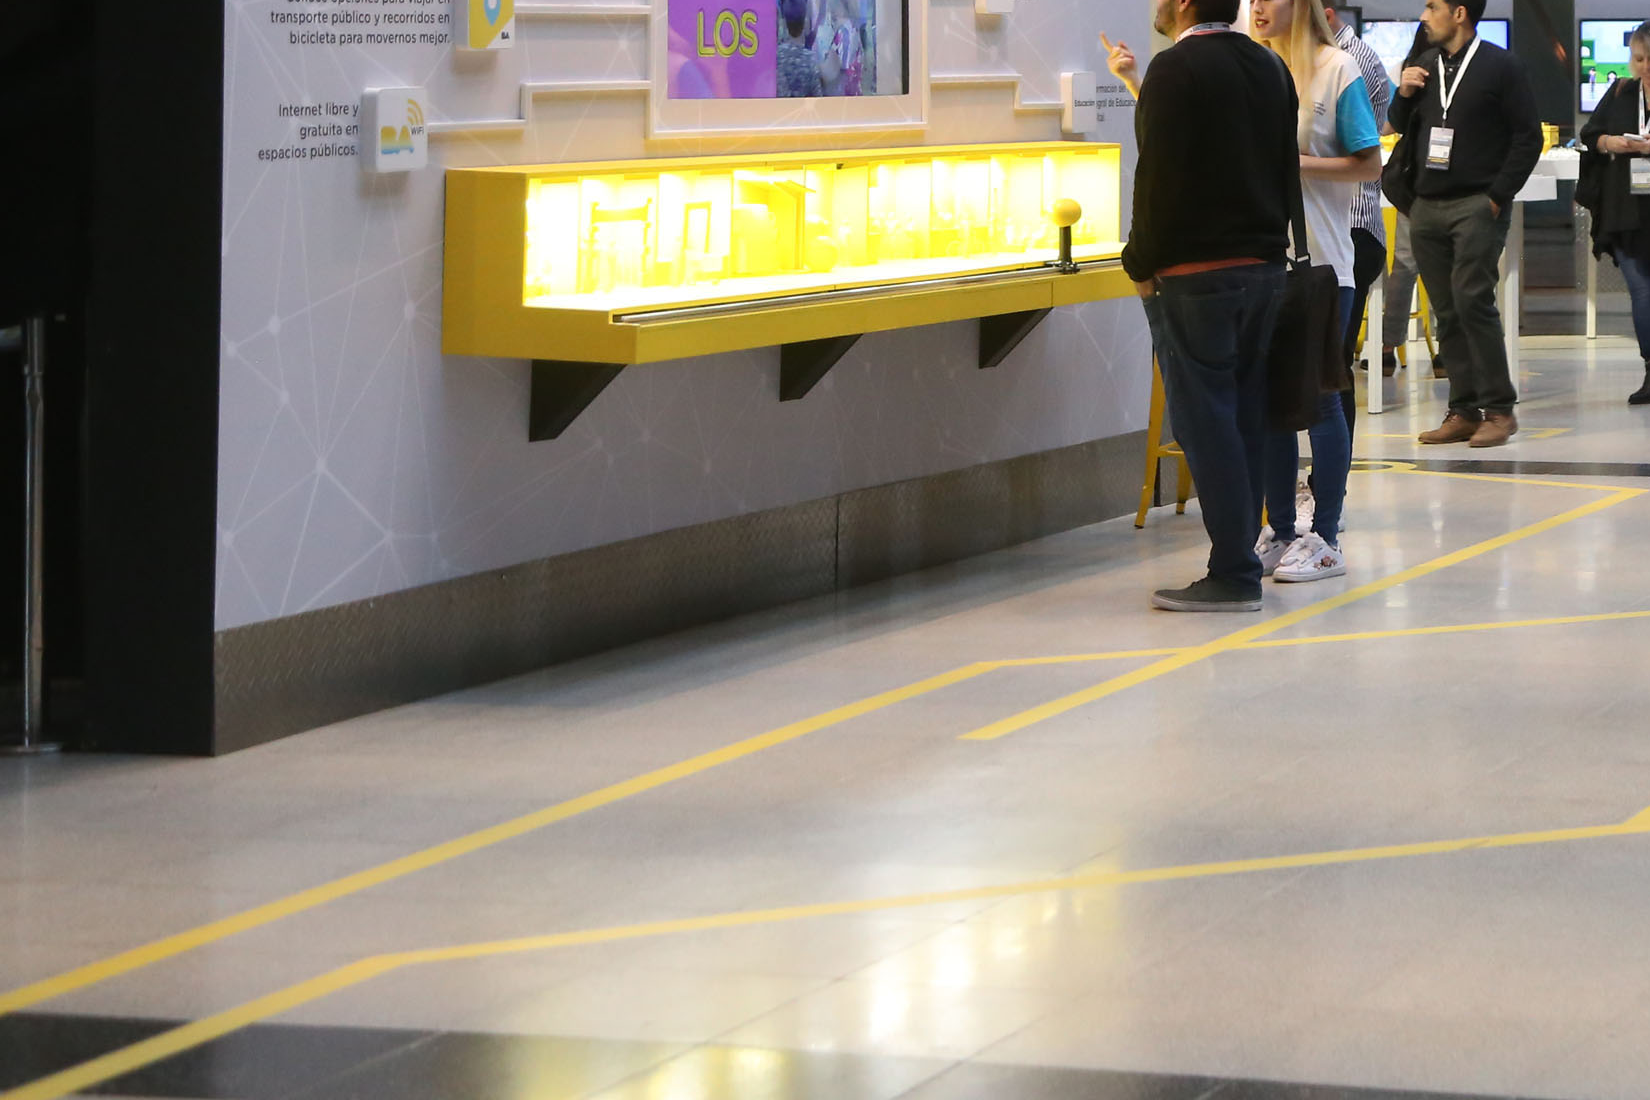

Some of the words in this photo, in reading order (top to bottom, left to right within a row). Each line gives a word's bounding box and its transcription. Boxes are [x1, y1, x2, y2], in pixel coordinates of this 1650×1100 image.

[270, 11, 328, 26] transporte
[332, 9, 370, 26] público
[374, 13, 380, 25] y
[383, 10, 435, 24] recorridos
[438, 13, 450, 23] en
[290, 30, 336, 45] bicicleta
[339, 33, 363, 46] para
[366, 33, 417, 44] movernos
[419, 32, 450, 46] mejor.
[696, 8, 759, 58] LOS
[279, 103, 322, 117] Internet
[325, 102, 349, 116] libre
[352, 104, 359, 116] y
[300, 124, 343, 140] gratuita
[345, 124, 359, 135] en
[258, 145, 307, 162] espacios
[310, 143, 359, 160] públicos.
